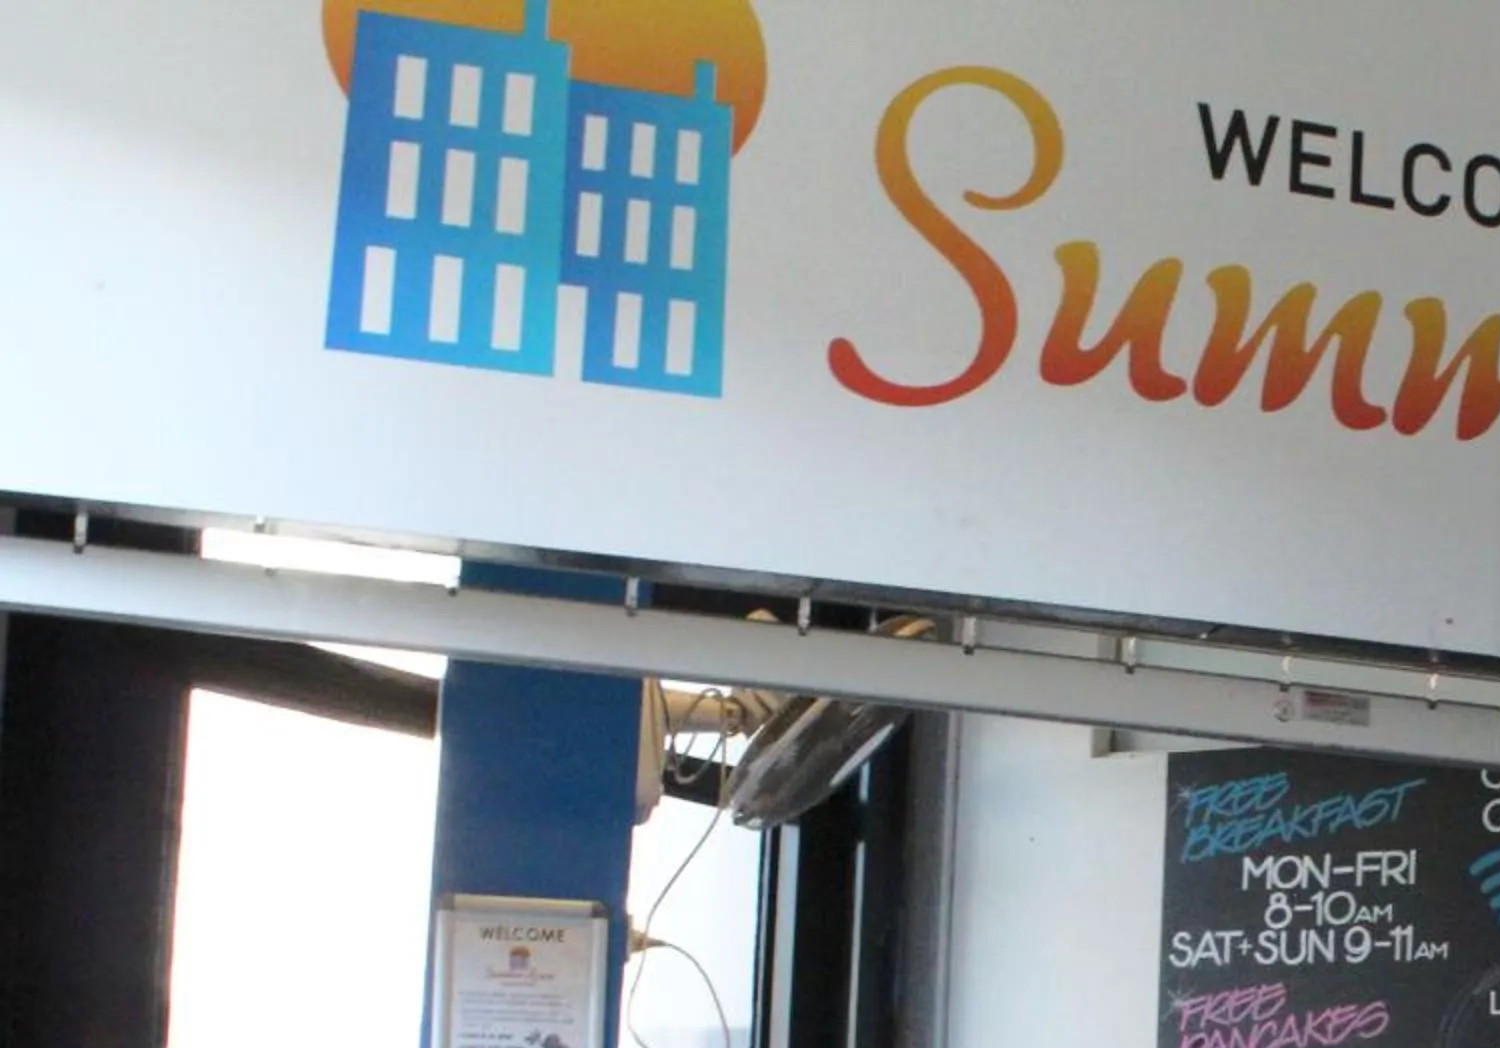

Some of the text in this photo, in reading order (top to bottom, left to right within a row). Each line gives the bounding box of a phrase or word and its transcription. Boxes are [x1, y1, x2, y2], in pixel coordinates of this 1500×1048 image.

[1181, 778, 1427, 864] BREAKFAST
[1241, 849, 1417, 891] MON-FRI
[480, 925, 566, 943] WELCOME
[1177, 982, 1288, 1033] FREE
